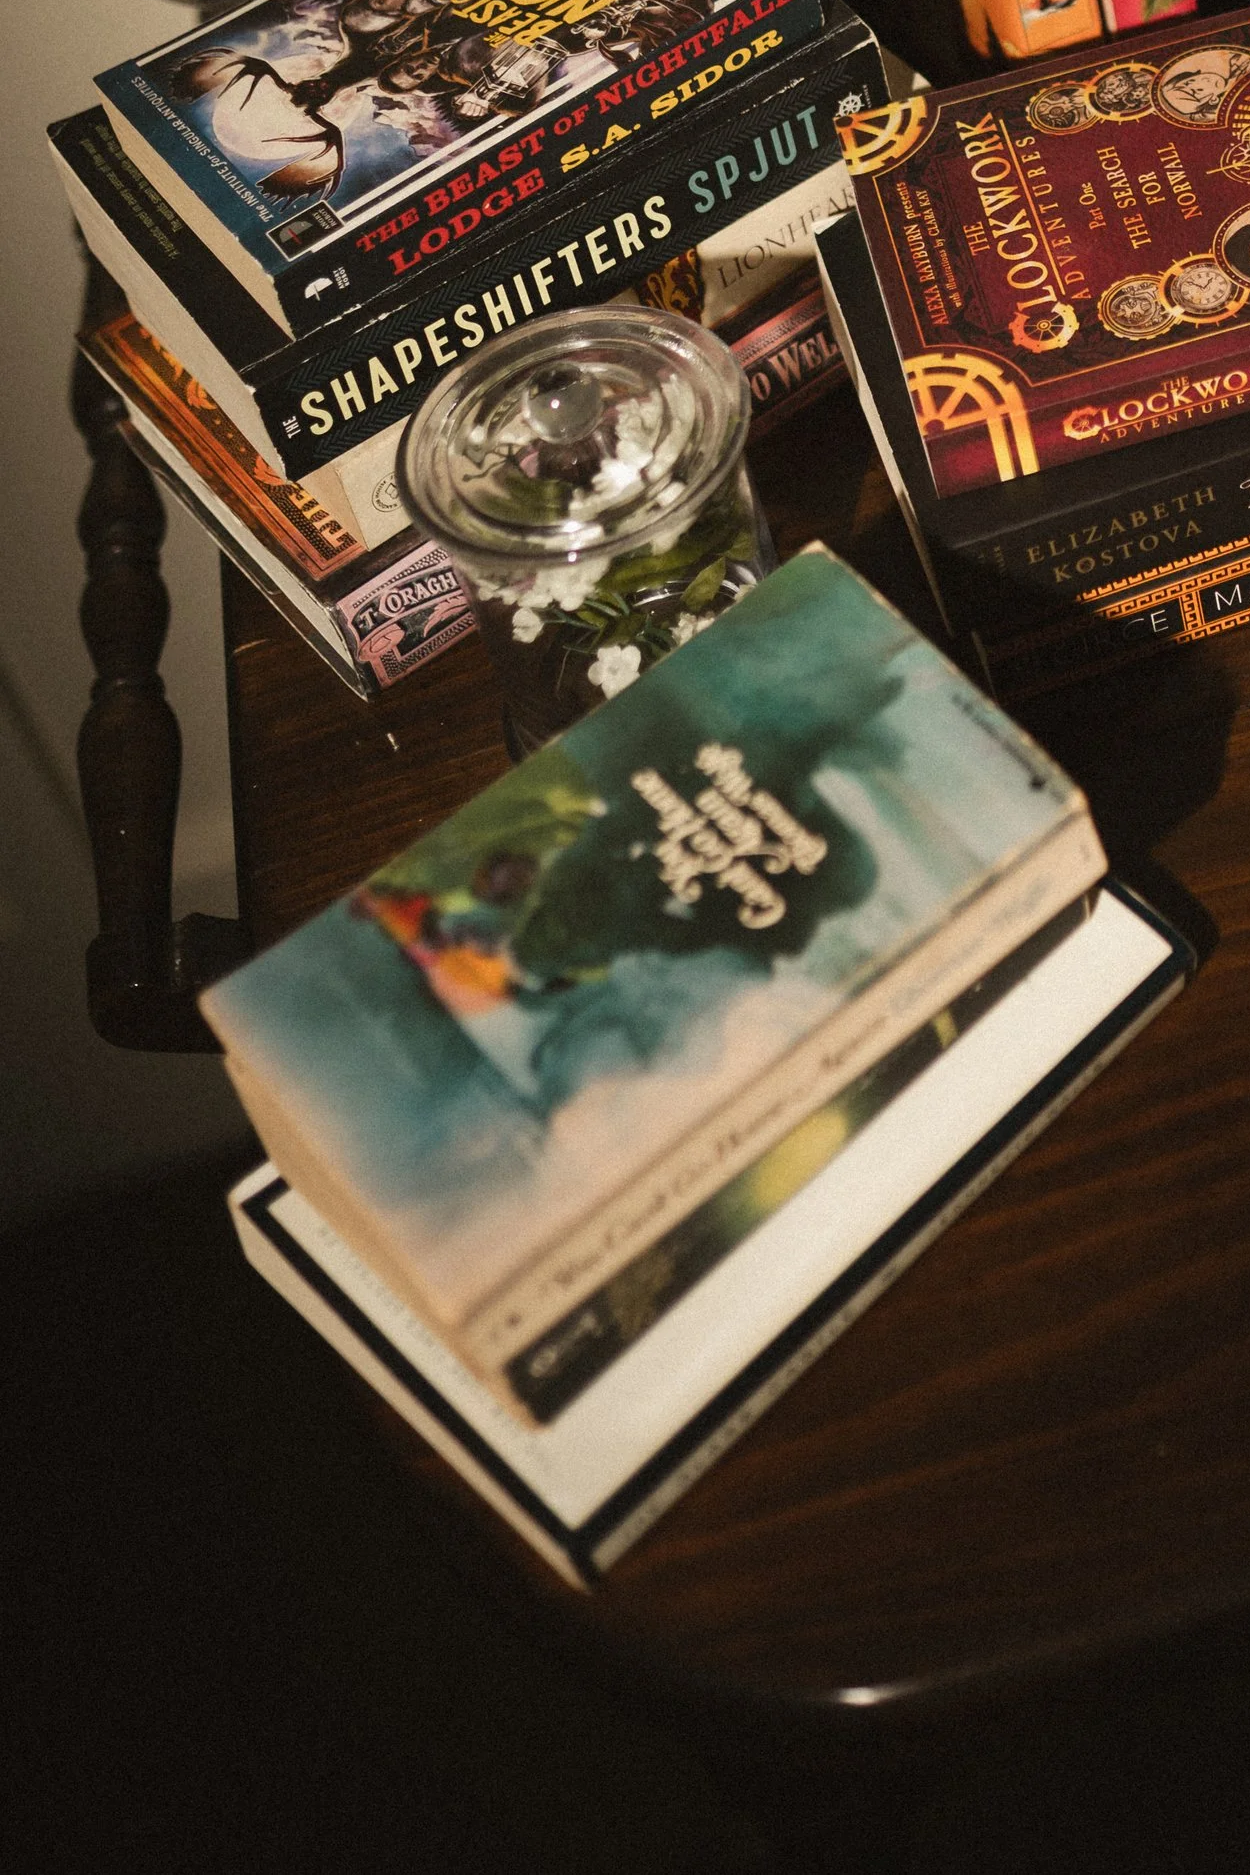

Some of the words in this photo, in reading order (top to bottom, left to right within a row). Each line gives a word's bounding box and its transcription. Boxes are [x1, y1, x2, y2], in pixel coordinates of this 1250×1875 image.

[129, 72, 179, 123] ANTIQUITIES
[170, 116, 211, 158] SINGULAR
[388, 167, 546, 274] LODGE
[560, 123, 642, 173] S.A.
[650, 29, 784, 120] SIDOR
[204, 150, 225, 171] for
[356, 208, 420, 252] THE
[423, 129, 546, 217] BEAST
[553, 104, 590, 137] OF
[1096, 145, 1137, 209] SEARCH
[217, 164, 260, 208] INSTITUTE
[896, 181, 922, 220] presents
[915, 190, 931, 211] KAY
[1079, 182, 1100, 206] One
[1138, 171, 1166, 206] FOR
[1157, 142, 1203, 221] NORWALL
[254, 202, 275, 224] The
[311, 211, 332, 231] ANGRY
[925, 210, 940, 237] CLARA
[1016, 136, 1093, 302] ADVENTURES
[1088, 207, 1107, 230] Part
[1124, 212, 1152, 250] THE
[934, 237, 946, 249] by
[956, 112, 1080, 354] CLOCKWORK
[963, 221, 991, 257] THE
[283, 416, 301, 439] THE
[301, 195, 672, 435] SHAPESHIFTERS
[688, 105, 820, 214] SPJUT
[904, 224, 935, 283] RAYBURN
[937, 248, 960, 290] illustrations
[332, 269, 346, 291] ANGRY
[338, 266, 351, 287] ROBOT
[925, 285, 949, 326] ALEXA
[949, 291, 962, 308] with
[1160, 375, 1189, 391] THE
[1027, 486, 1217, 565] ELIZABETH
[1051, 520, 1202, 585] KOSTOVA
